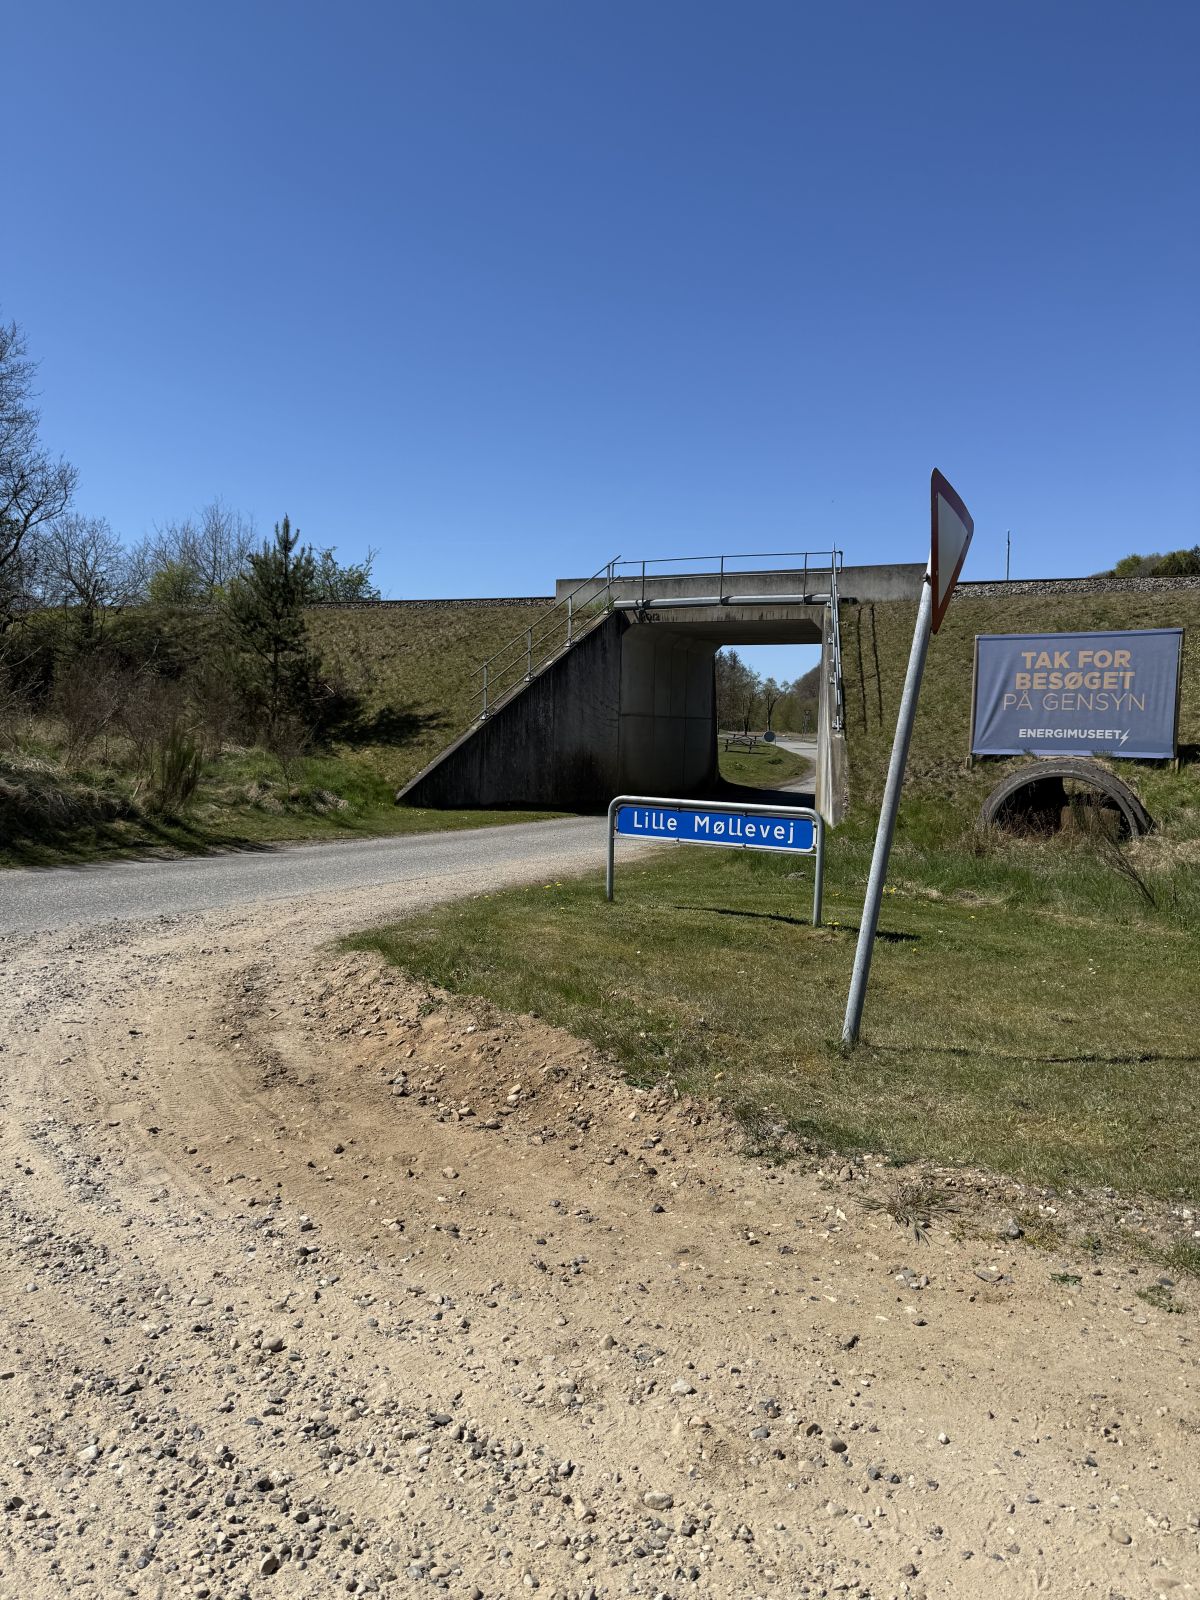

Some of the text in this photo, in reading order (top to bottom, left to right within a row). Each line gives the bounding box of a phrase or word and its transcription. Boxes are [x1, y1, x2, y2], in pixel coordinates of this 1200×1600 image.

[1021, 650, 1130, 669] TAK FOR
[1015, 671, 1135, 690] BESØGET
[1003, 690, 1145, 711] PÅ GENSYN
[1018, 728, 1122, 739] ENERGIMUSEET
[633, 811, 794, 843] Lille Møllevej
